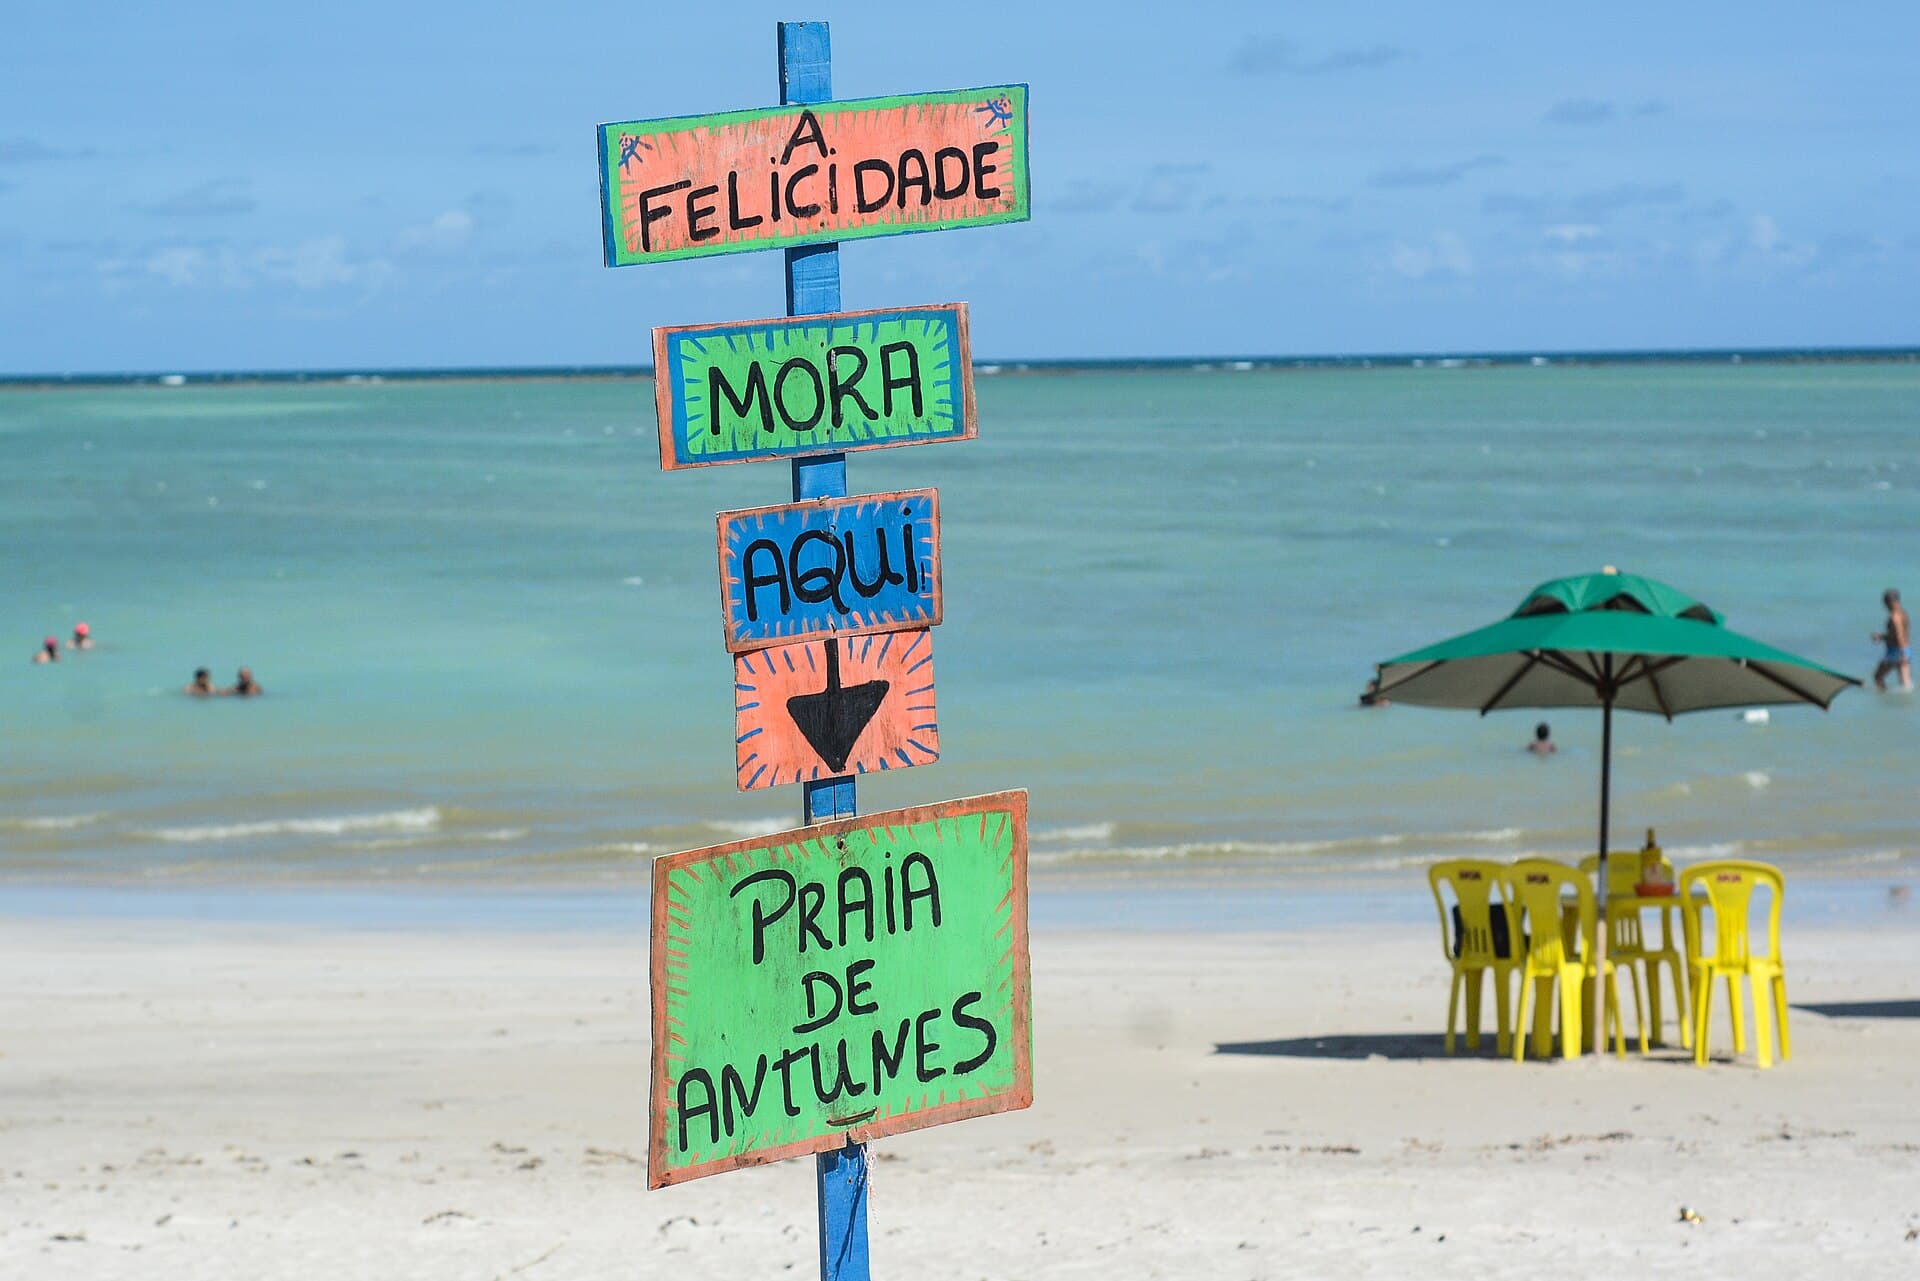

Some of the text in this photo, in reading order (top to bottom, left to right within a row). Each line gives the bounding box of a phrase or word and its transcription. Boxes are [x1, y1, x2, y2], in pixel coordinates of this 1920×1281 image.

[781, 109, 829, 165] A
[639, 142, 1001, 252] FELICIDADE
[708, 341, 924, 435] MORA
[730, 852, 941, 965] PRAIA
[793, 959, 879, 1033] DE
[677, 992, 997, 1152] ANTUNES
